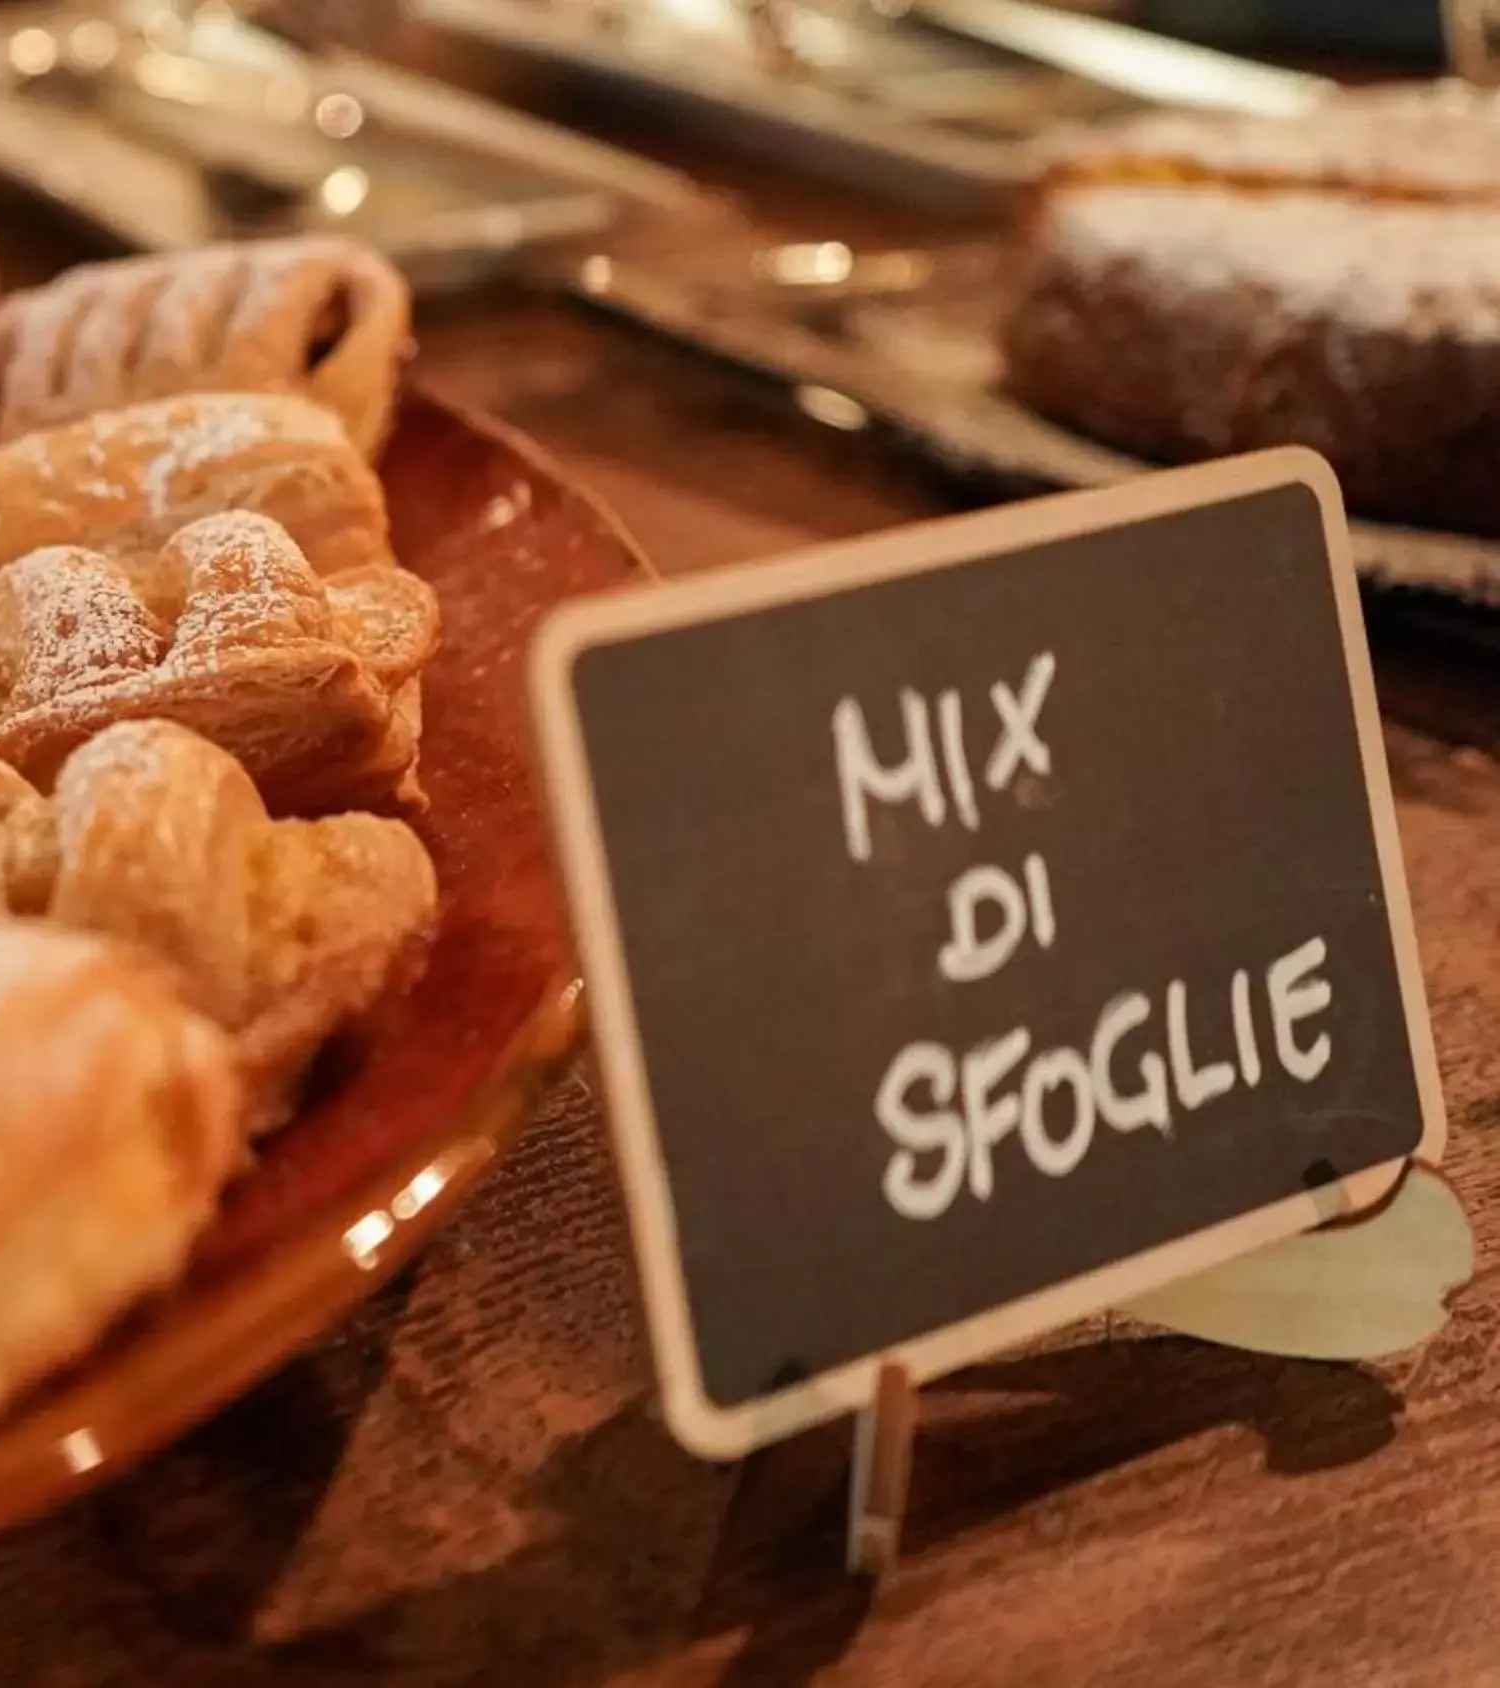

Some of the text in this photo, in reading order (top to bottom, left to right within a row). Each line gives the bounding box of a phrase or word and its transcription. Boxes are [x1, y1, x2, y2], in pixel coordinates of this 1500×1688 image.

[833, 651, 1055, 861] MIX
[938, 853, 1055, 983] DI
[875, 936, 1333, 1220] SFOGLIE
